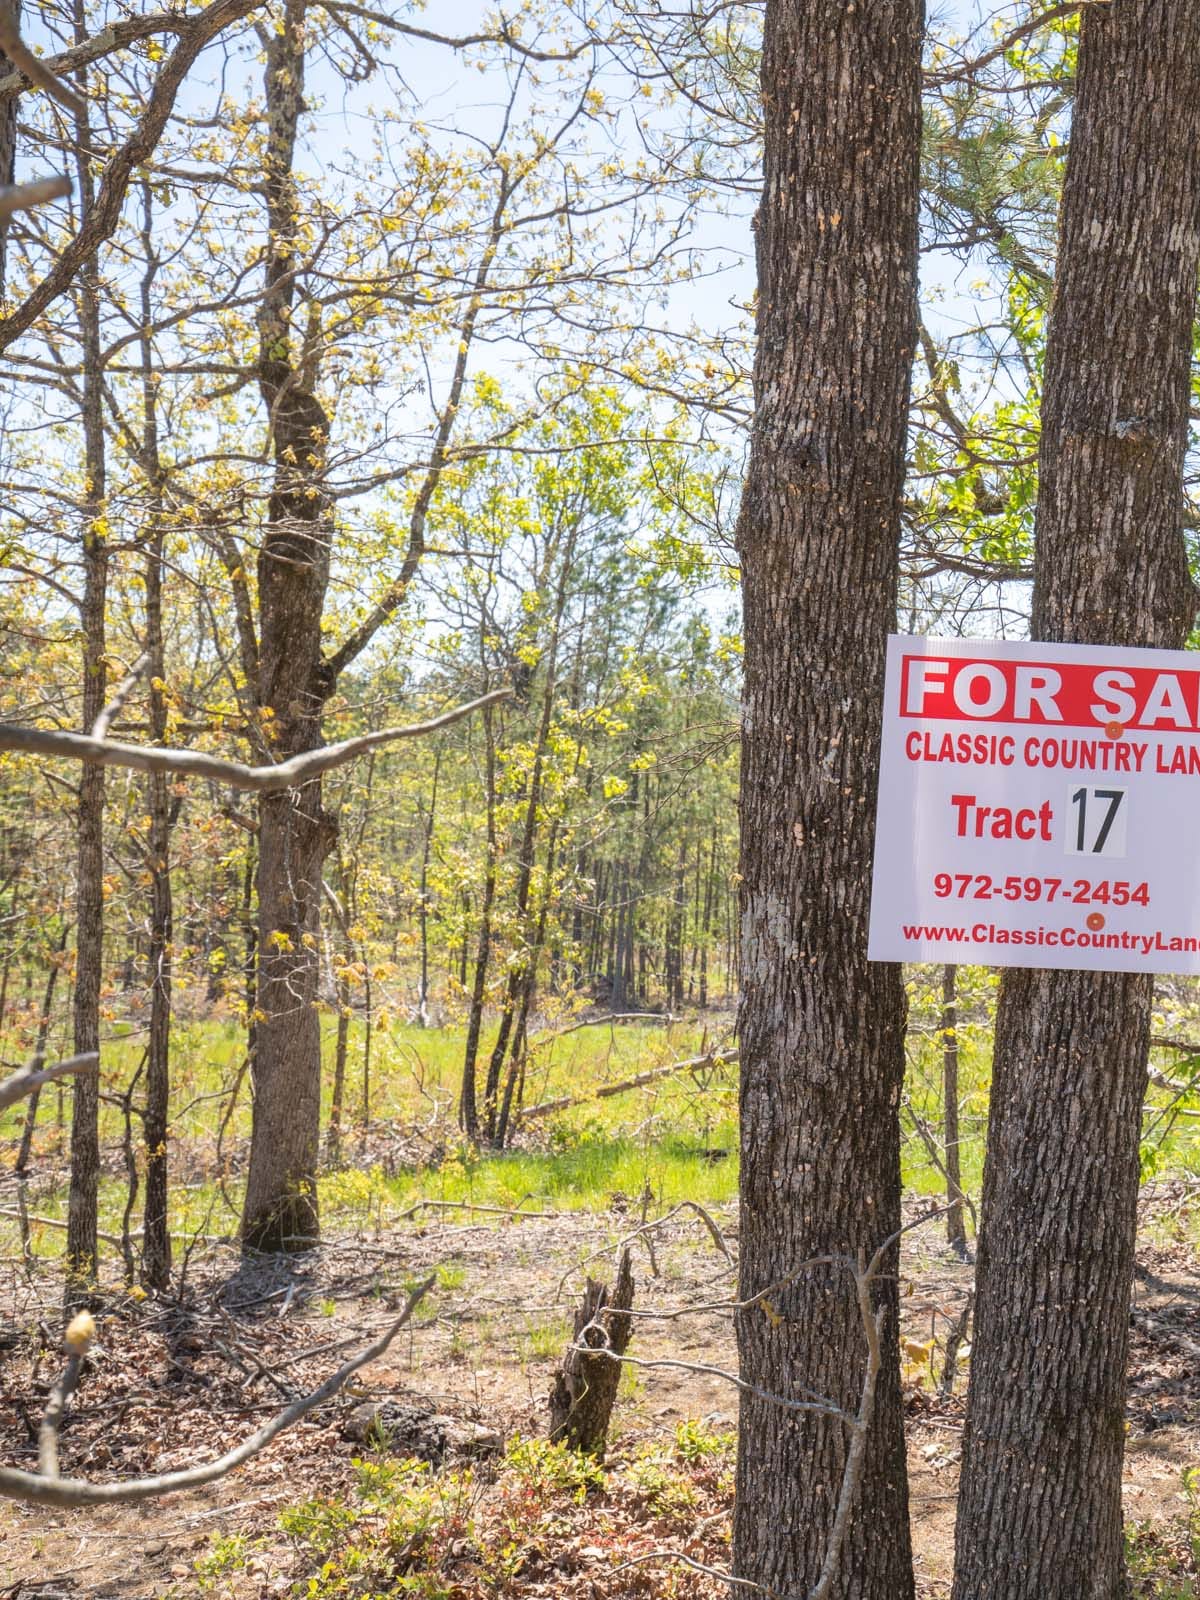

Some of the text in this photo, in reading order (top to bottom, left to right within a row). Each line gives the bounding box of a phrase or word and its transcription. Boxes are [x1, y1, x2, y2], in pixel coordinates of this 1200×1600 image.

[905, 661, 1064, 721] FOR
[905, 731, 1015, 766] CLASSIC
[1024, 737, 1149, 772] COUNTRY
[951, 787, 1124, 854] Tract 17
[934, 873, 1150, 906] 972-597-2454
